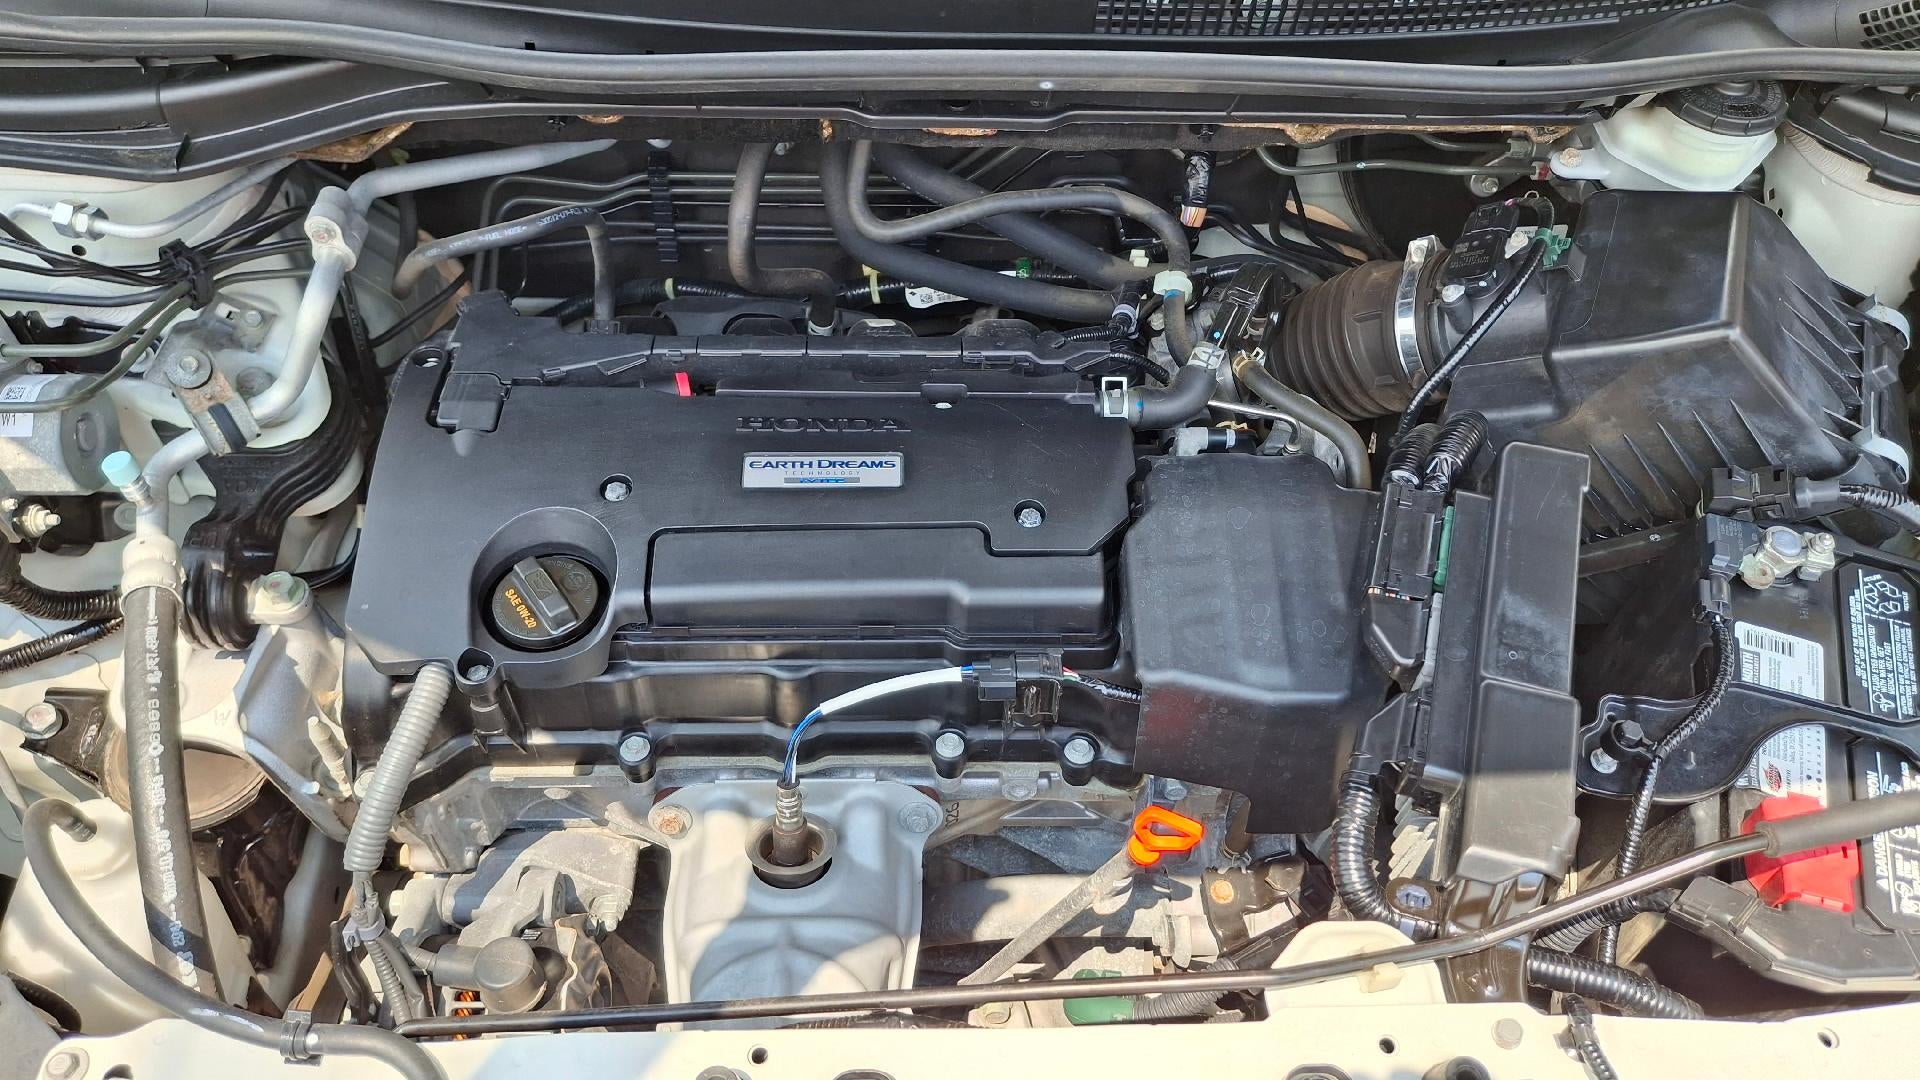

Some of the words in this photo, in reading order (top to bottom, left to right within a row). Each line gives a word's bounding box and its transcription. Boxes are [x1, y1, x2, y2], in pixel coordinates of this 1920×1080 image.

[736, 416, 912, 432] HONDA
[749, 460, 813, 469] EARTH
[818, 459, 896, 469] DREAMS
[505, 588, 522, 606] SAE
[1883, 642, 1891, 656] FAST
[1742, 652, 1753, 680] MONTH
[1885, 657, 1893, 670] HELP
[1872, 673, 1880, 691] FLUSH
